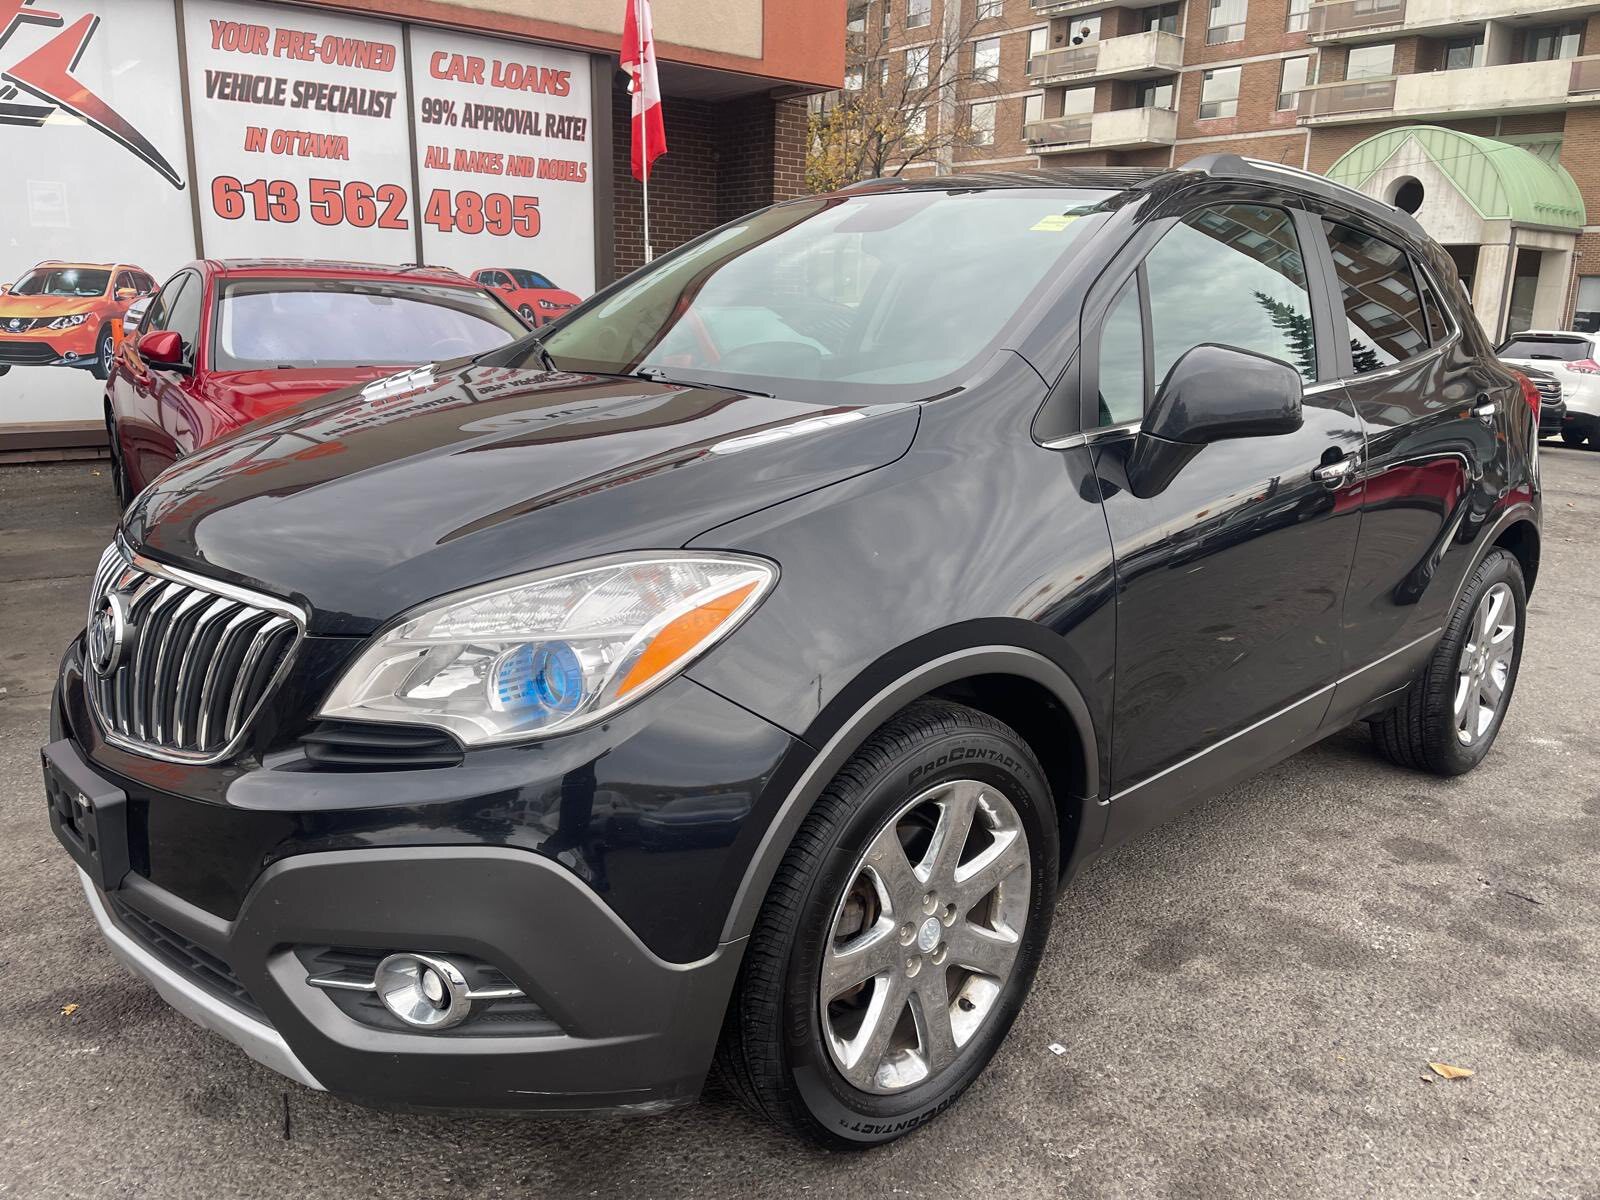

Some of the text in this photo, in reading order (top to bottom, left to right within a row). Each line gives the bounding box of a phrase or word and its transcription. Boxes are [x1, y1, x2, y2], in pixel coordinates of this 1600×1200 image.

[210, 19, 396, 73] YOUR PRE-OWNED
[204, 69, 397, 119] VEHICLE SPECIALIST
[429, 50, 571, 97] CAR LOANS
[421, 97, 587, 142] 99% APPROVAL RATE!
[244, 126, 349, 161] IN OTTAWA
[424, 145, 587, 183] ALL MAKES AND MODELS
[211, 175, 541, 238] 613 562 4895
